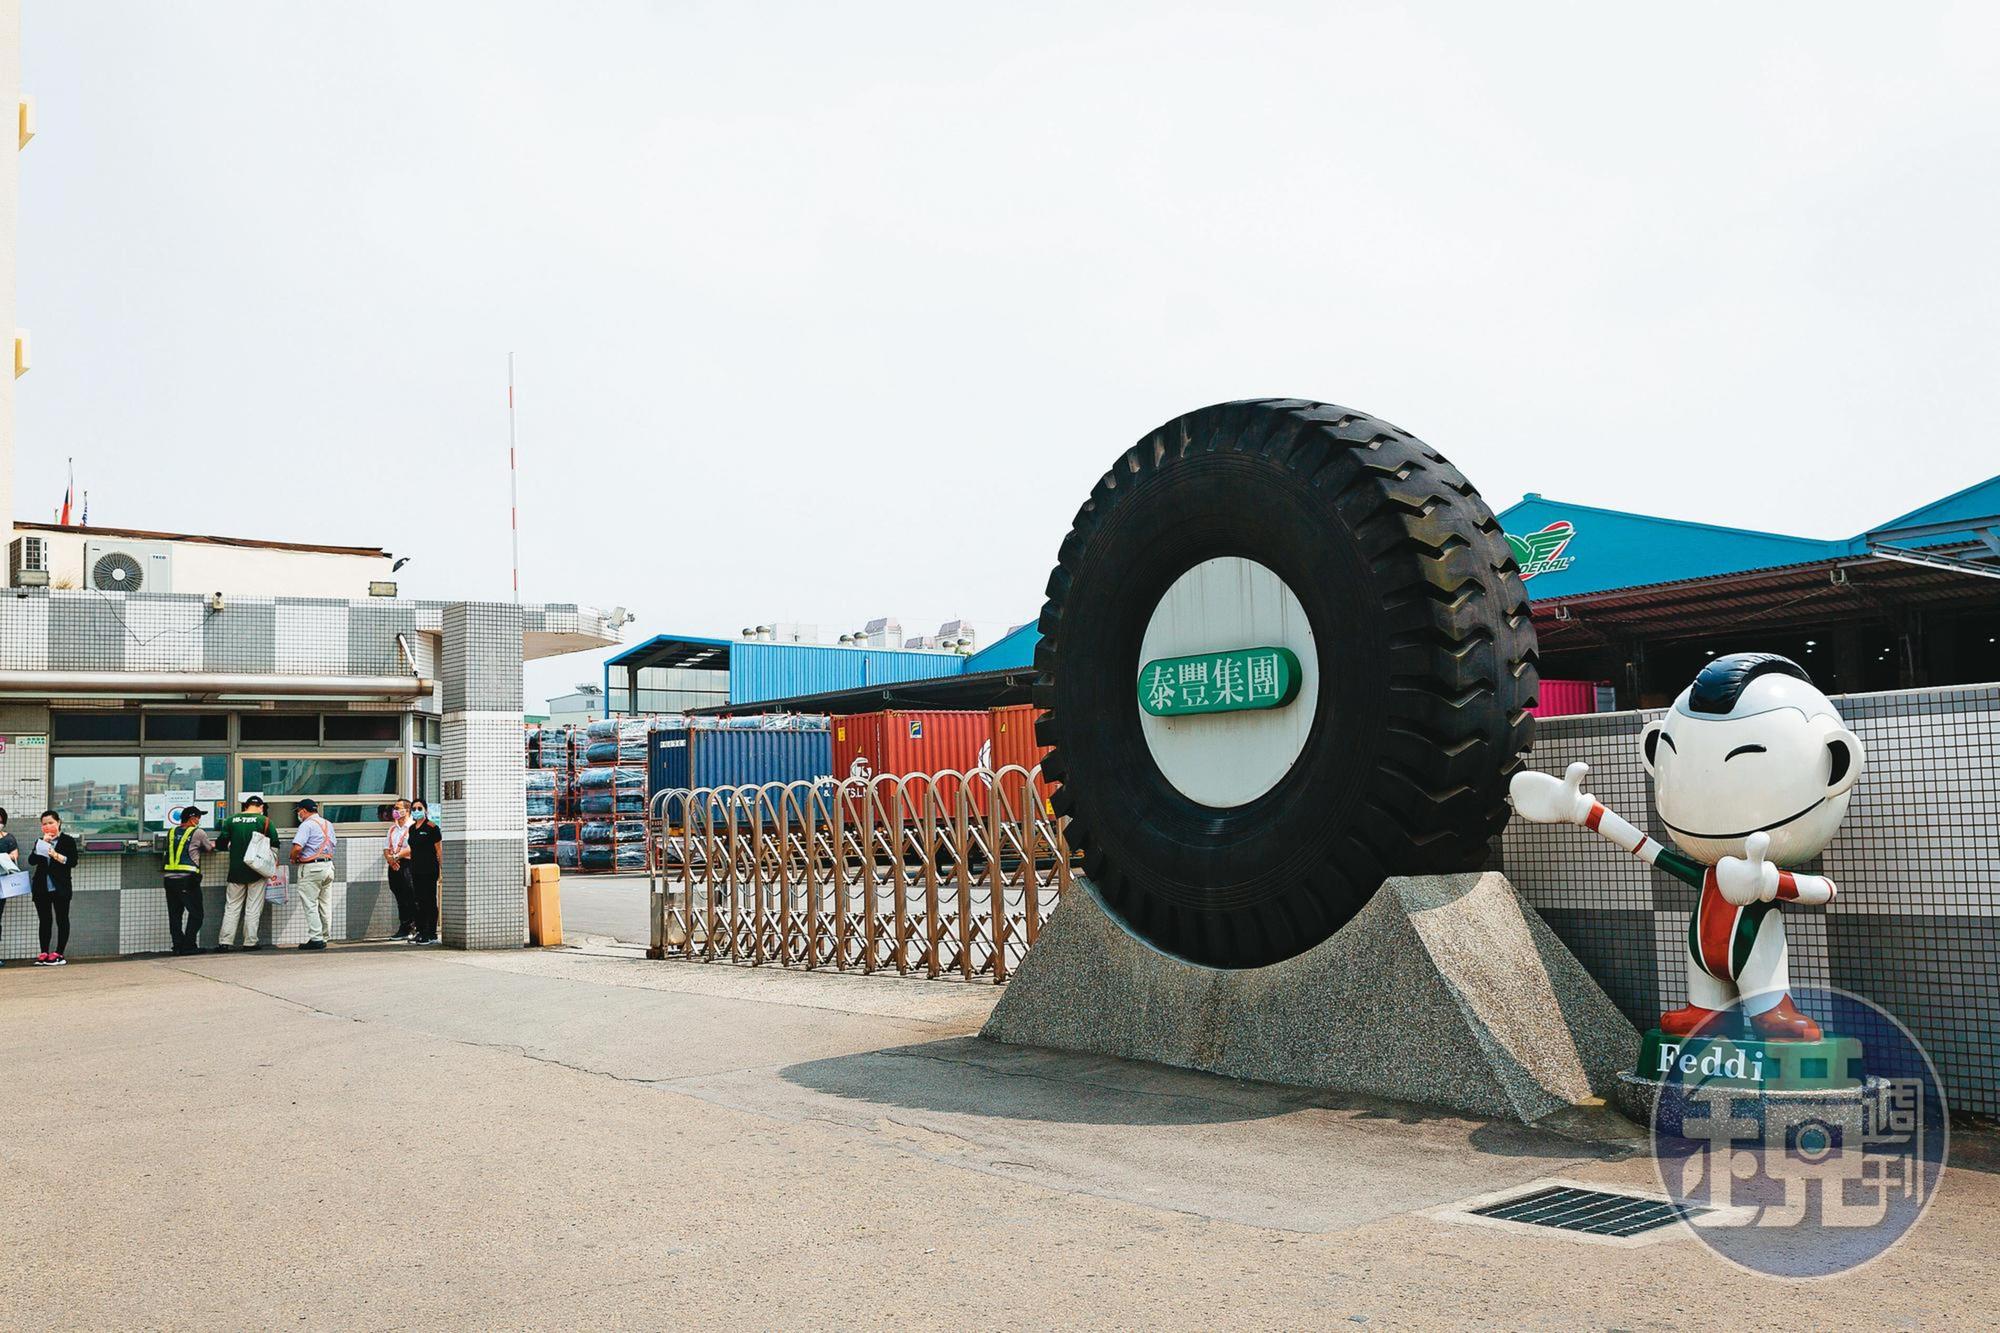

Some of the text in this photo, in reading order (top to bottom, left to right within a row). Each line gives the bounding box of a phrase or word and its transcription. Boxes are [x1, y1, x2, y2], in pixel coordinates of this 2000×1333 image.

[1520, 558, 1569, 574] DERAL
[1145, 653, 1279, 711] 泰豐集團
[1656, 1043, 1765, 1082] Feddi
